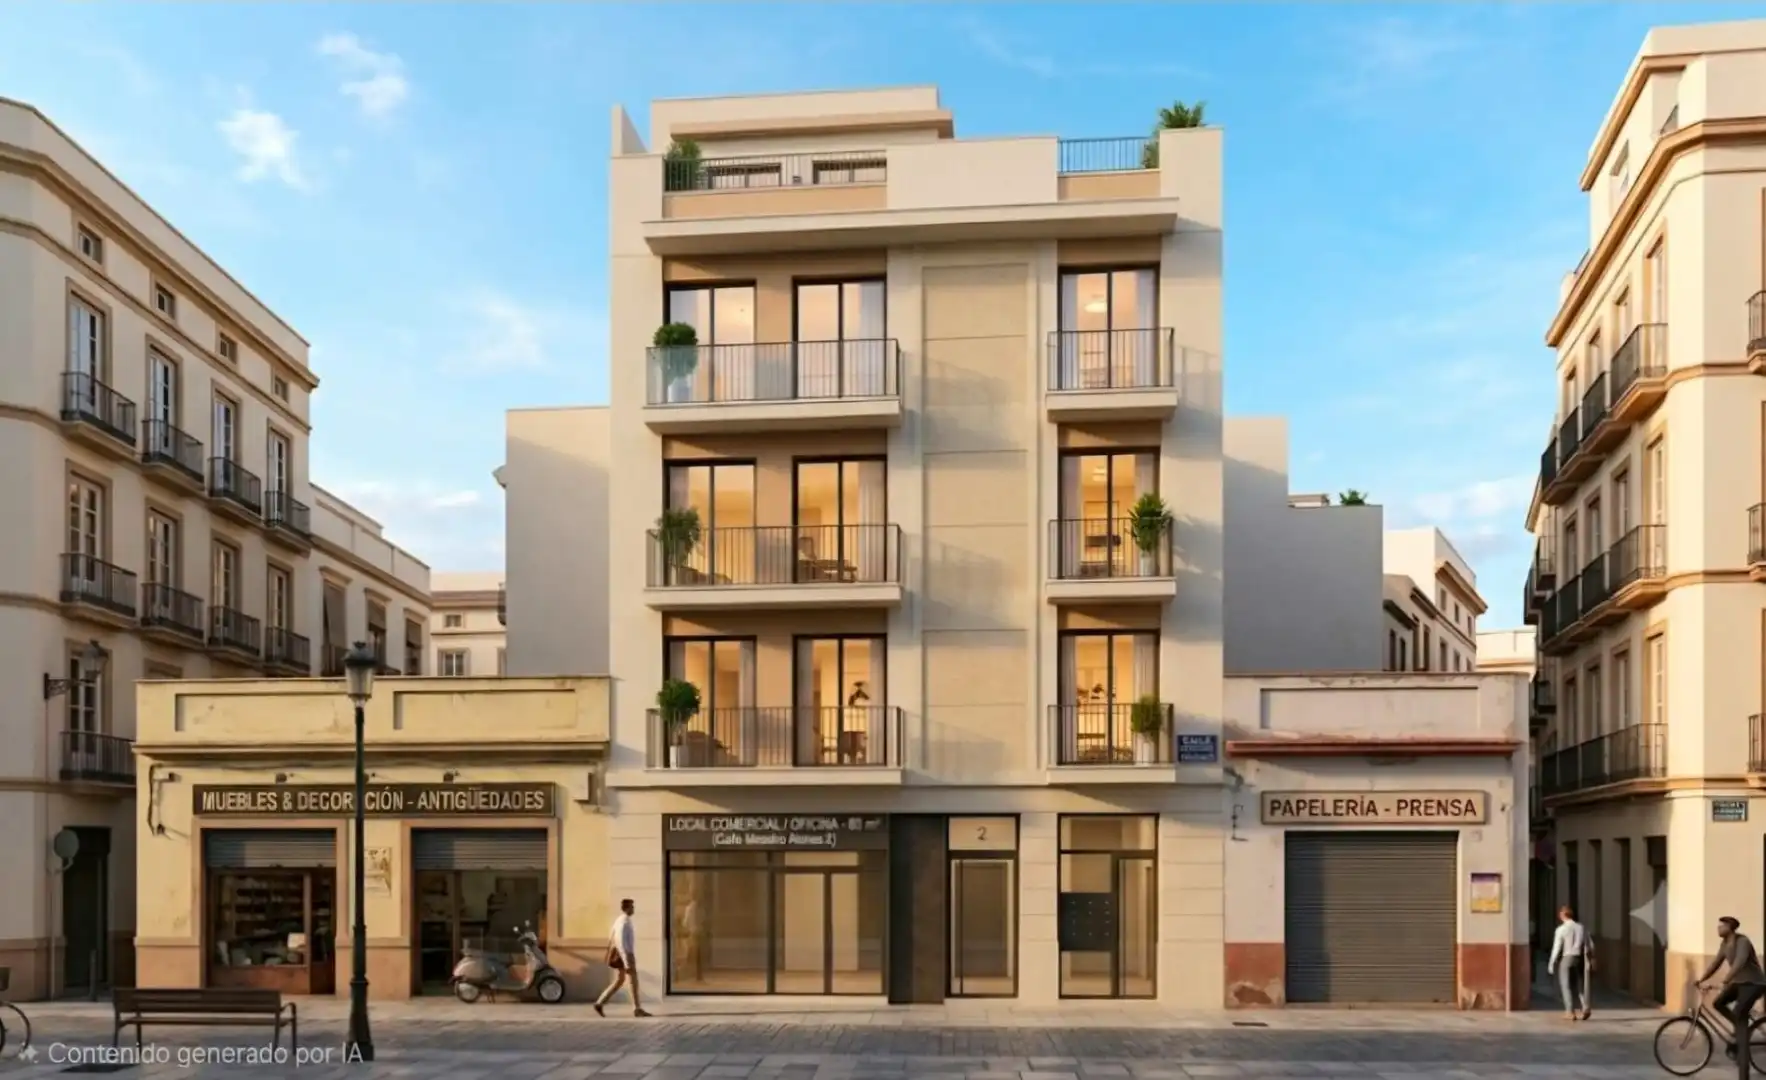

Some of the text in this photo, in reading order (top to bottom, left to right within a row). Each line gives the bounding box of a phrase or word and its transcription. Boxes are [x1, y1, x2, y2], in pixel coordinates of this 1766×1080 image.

[203, 791, 277, 811] MUEBLES
[283, 791, 293, 810] &
[297, 786, 404, 811] DECORCIÓN
[1270, 795, 1379, 817] PAPELERÍA
[1396, 799, 1477, 817] PRENSA
[669, 816, 708, 832] LOCAL
[977, 826, 988, 841] 2
